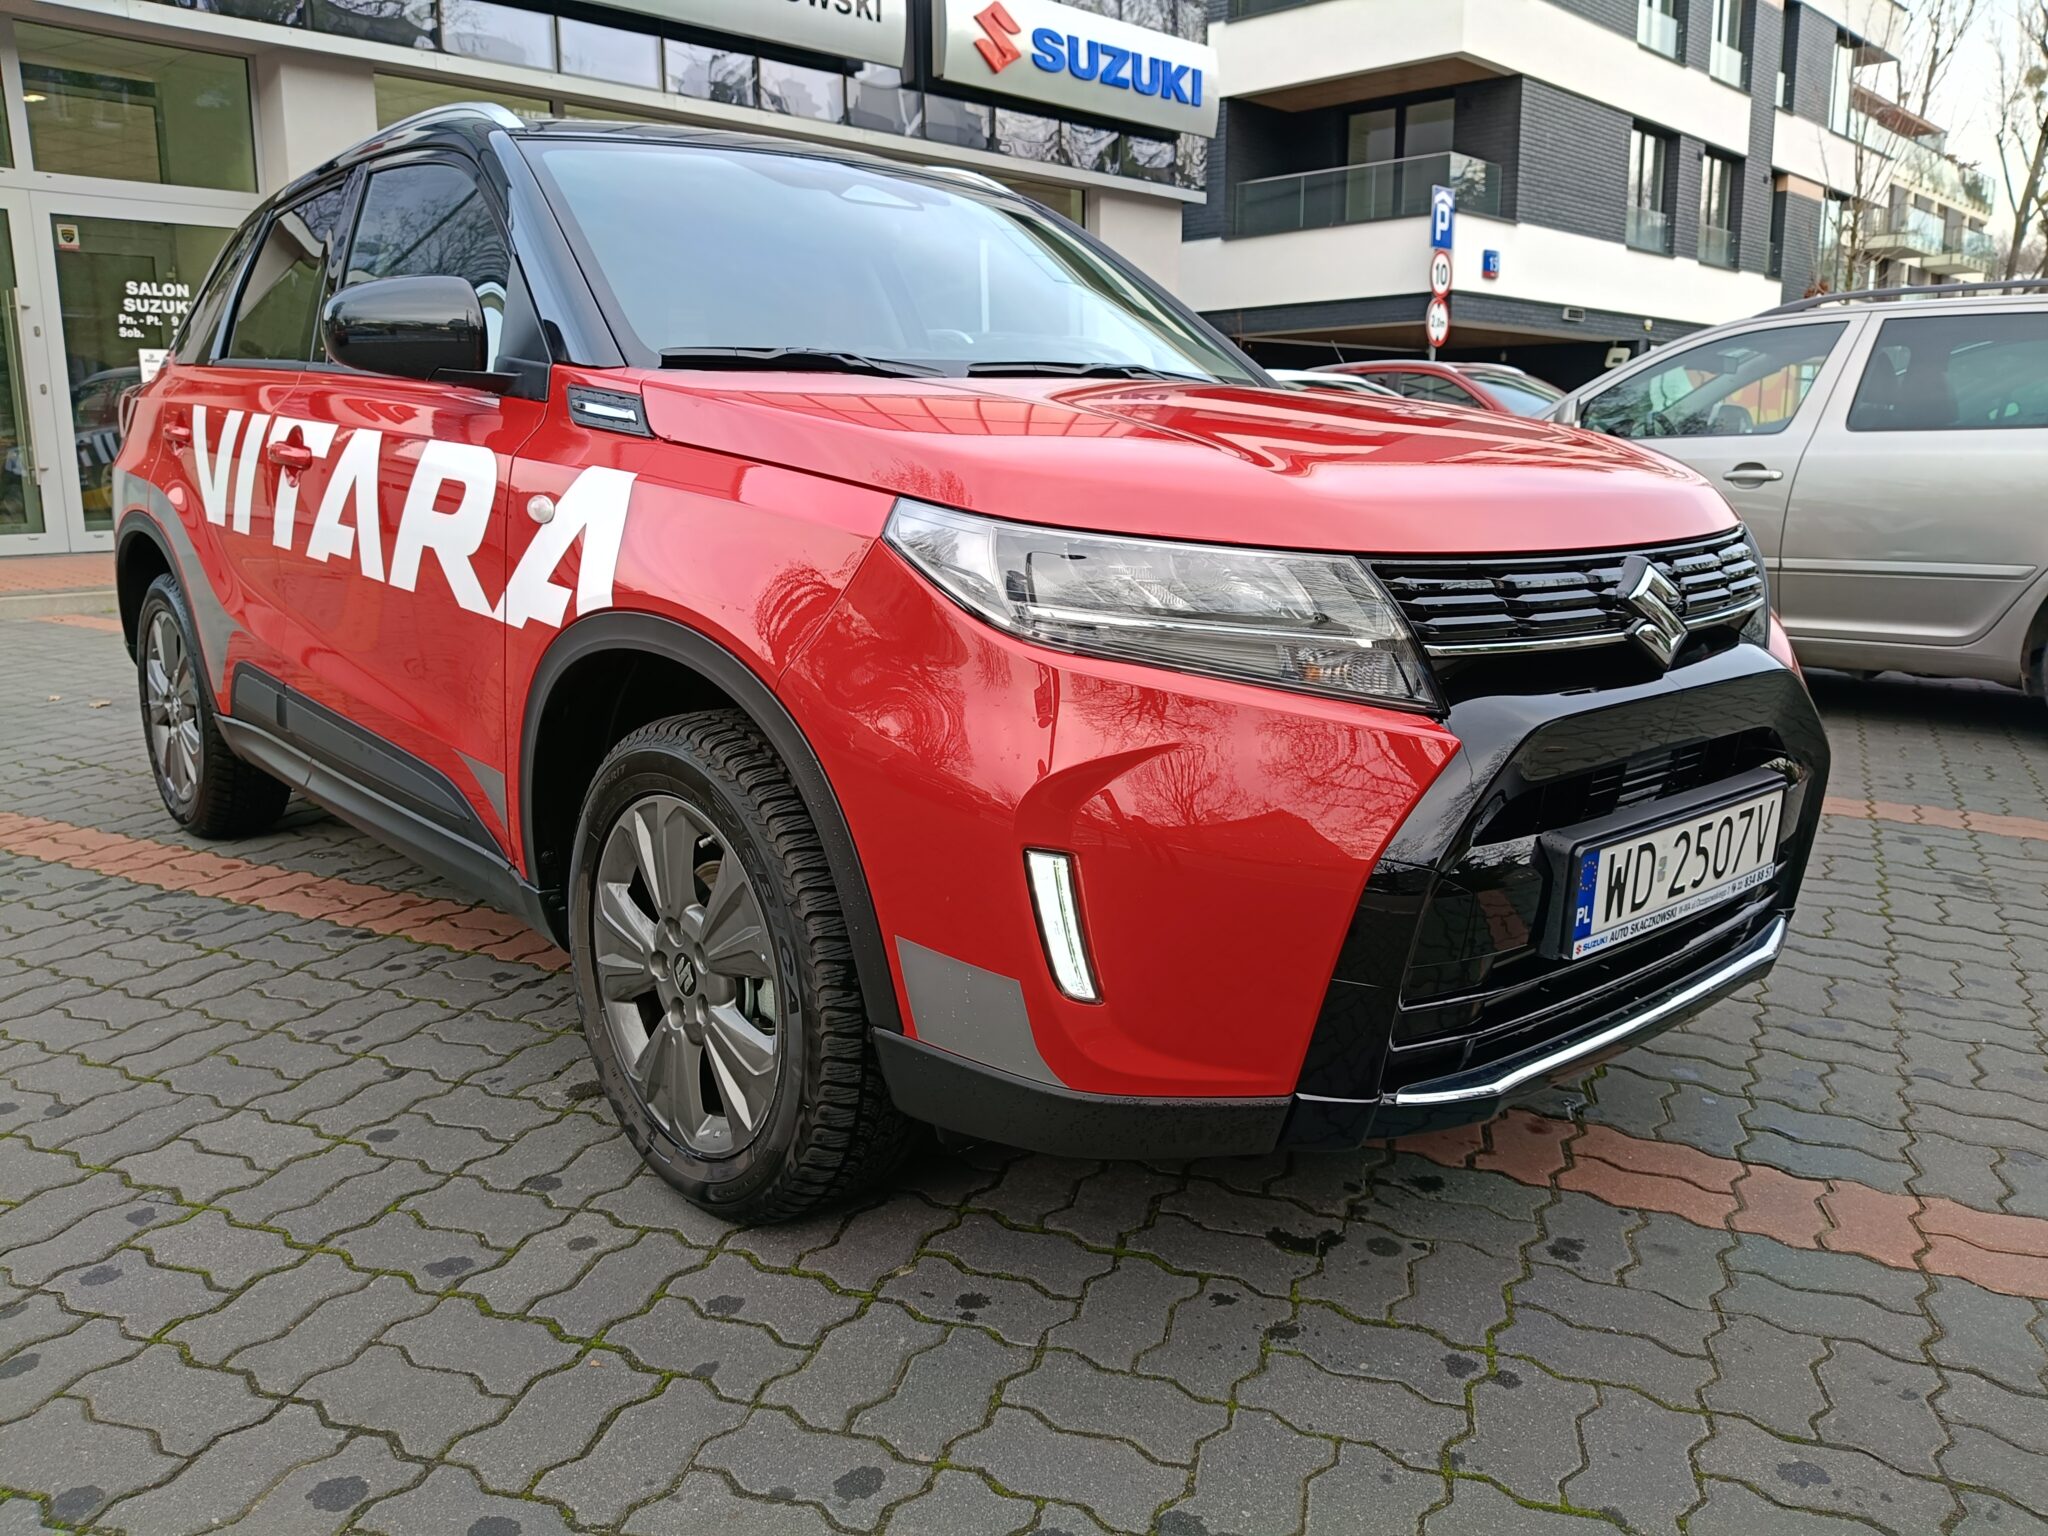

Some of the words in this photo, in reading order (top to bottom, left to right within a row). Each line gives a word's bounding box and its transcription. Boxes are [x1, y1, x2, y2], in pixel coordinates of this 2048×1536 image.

[1031, 27, 1203, 107] SUZUKI
[1436, 205, 1449, 241] P
[1435, 264, 1447, 285] 10
[125, 281, 190, 298] SALON
[123, 298, 193, 314] SUZUK
[118, 313, 137, 325] Pn.
[146, 315, 163, 326] Pt.
[118, 327, 145, 338] Sob.
[192, 404, 638, 630] VITARA
[1604, 841, 1657, 924] WD
[1667, 799, 1776, 900] 2507V
[1576, 905, 1591, 928] PL
[1583, 935, 1608, 951] SUZUKI
[1609, 926, 1629, 943] AUTO
[1630, 906, 1678, 935] SKACZKOWSKI
